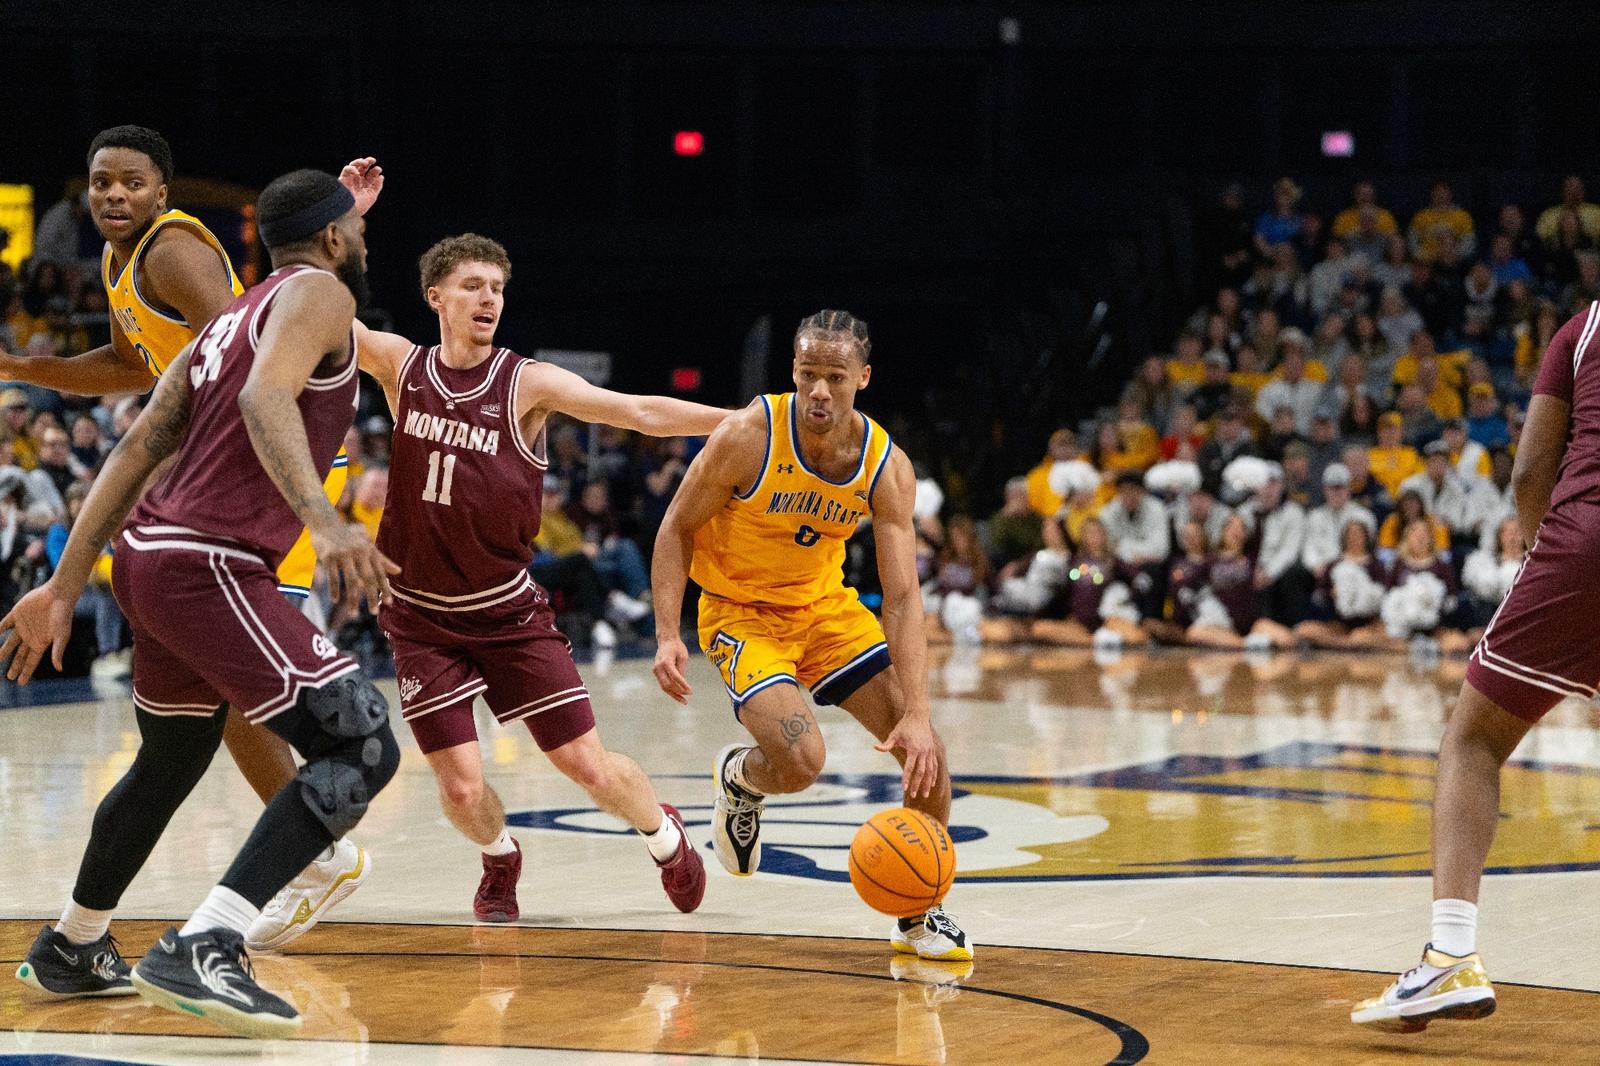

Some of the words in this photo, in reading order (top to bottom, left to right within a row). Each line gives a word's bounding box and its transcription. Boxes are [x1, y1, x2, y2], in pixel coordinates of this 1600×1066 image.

[403, 408, 500, 456] MONTANA
[421, 450, 457, 506] 11
[766, 490, 823, 517] MONTANA
[794, 524, 821, 548] 0
